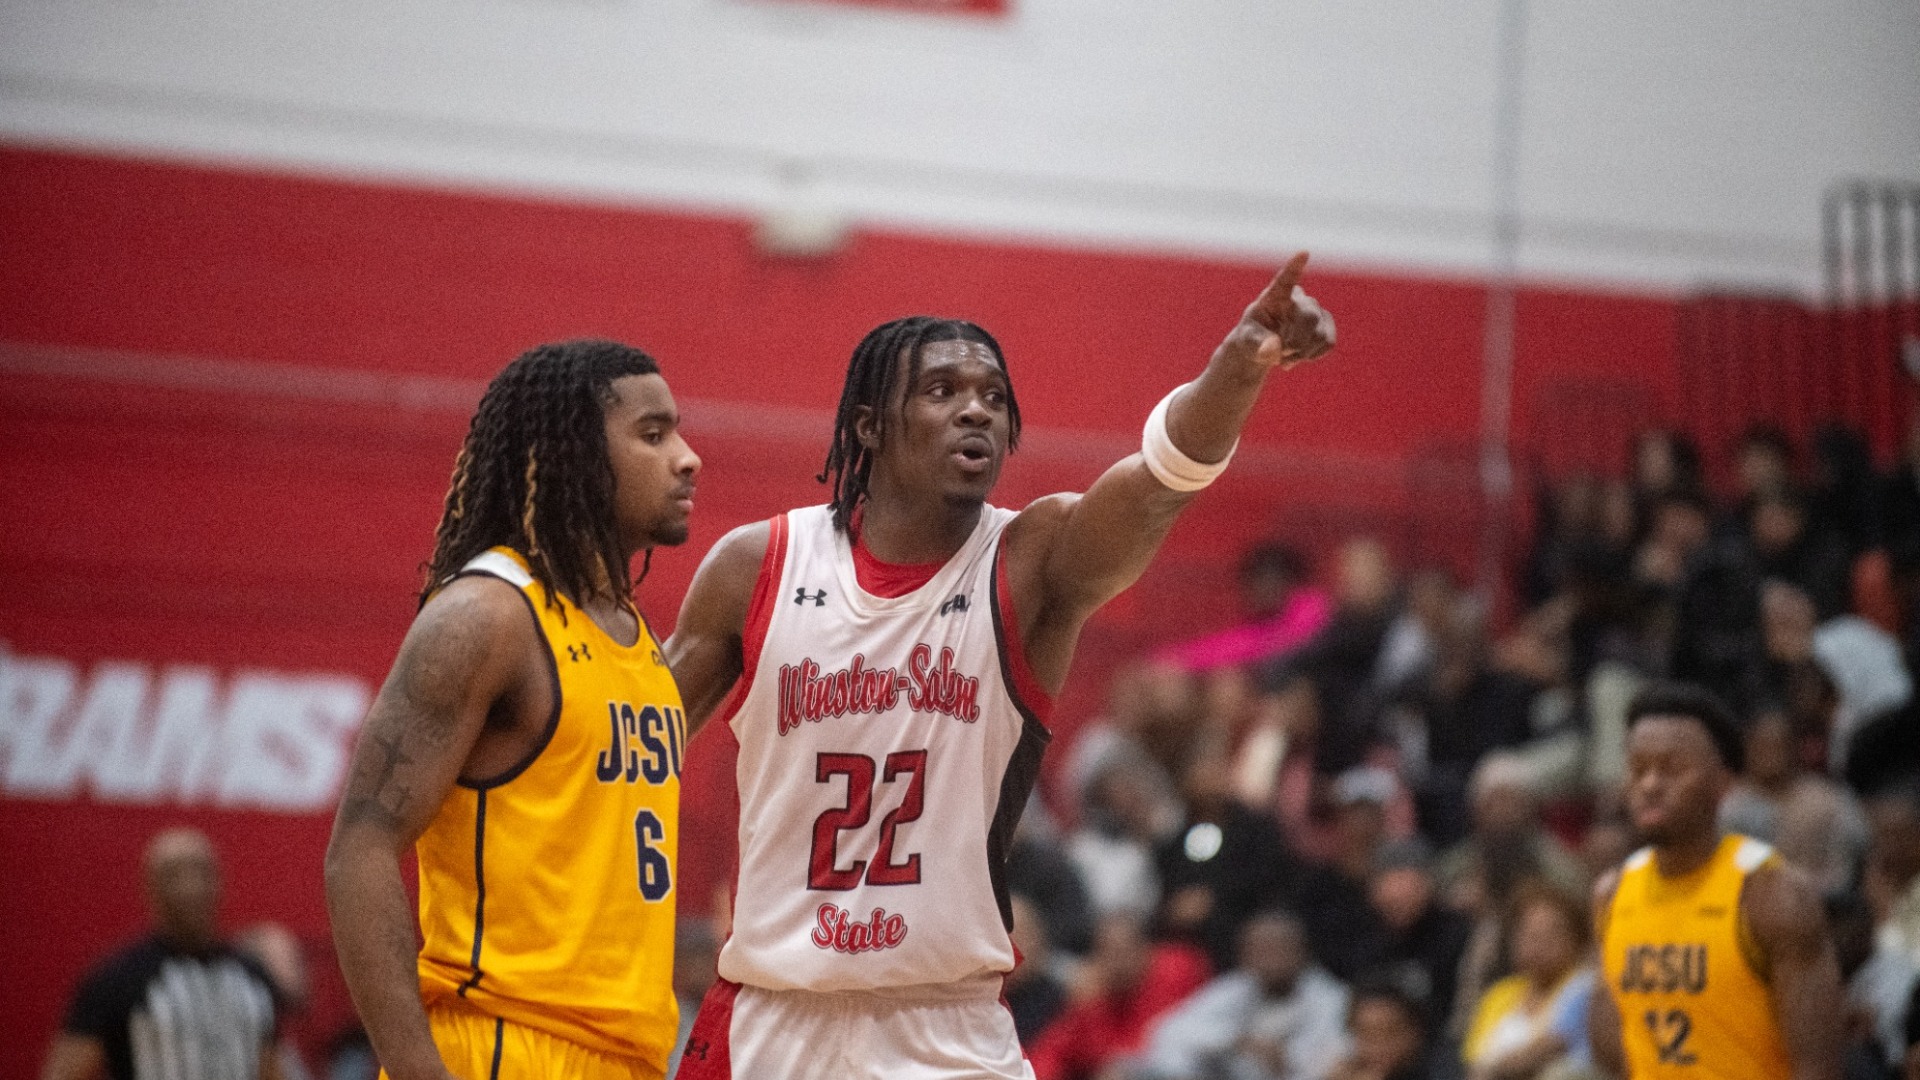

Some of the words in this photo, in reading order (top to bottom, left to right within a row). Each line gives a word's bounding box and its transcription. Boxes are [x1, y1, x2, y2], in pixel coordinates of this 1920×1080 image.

[0, 658, 369, 810] RAMS
[778, 644, 979, 736] Winston-Salem
[634, 807, 672, 904] 6
[806, 748, 928, 891] 22
[811, 903, 908, 955] State
